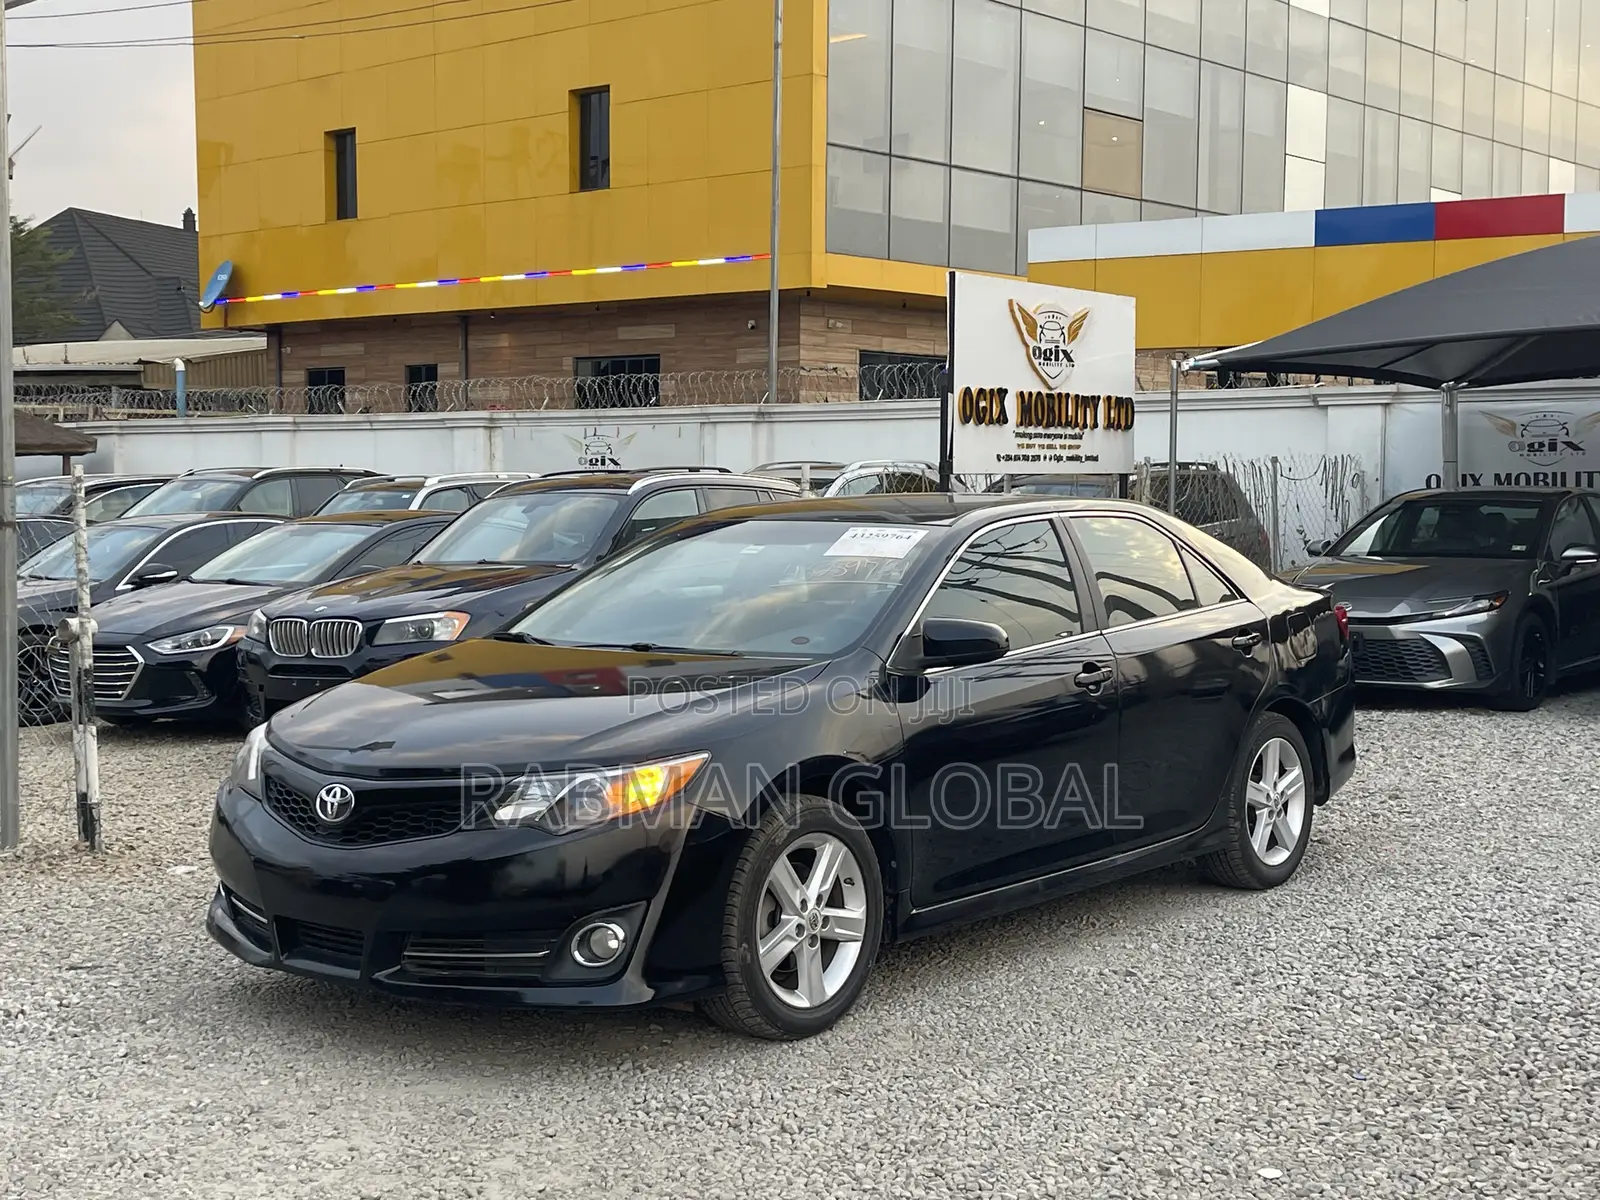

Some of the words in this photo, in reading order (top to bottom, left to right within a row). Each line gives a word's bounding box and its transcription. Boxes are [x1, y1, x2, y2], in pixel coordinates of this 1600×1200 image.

[958, 386, 1009, 426] OGIX
[1016, 391, 1101, 431] MOBILITY
[1103, 395, 1135, 432] LTD
[1425, 473, 1484, 489] OIX
[1494, 471, 1600, 489] MOBILIT
